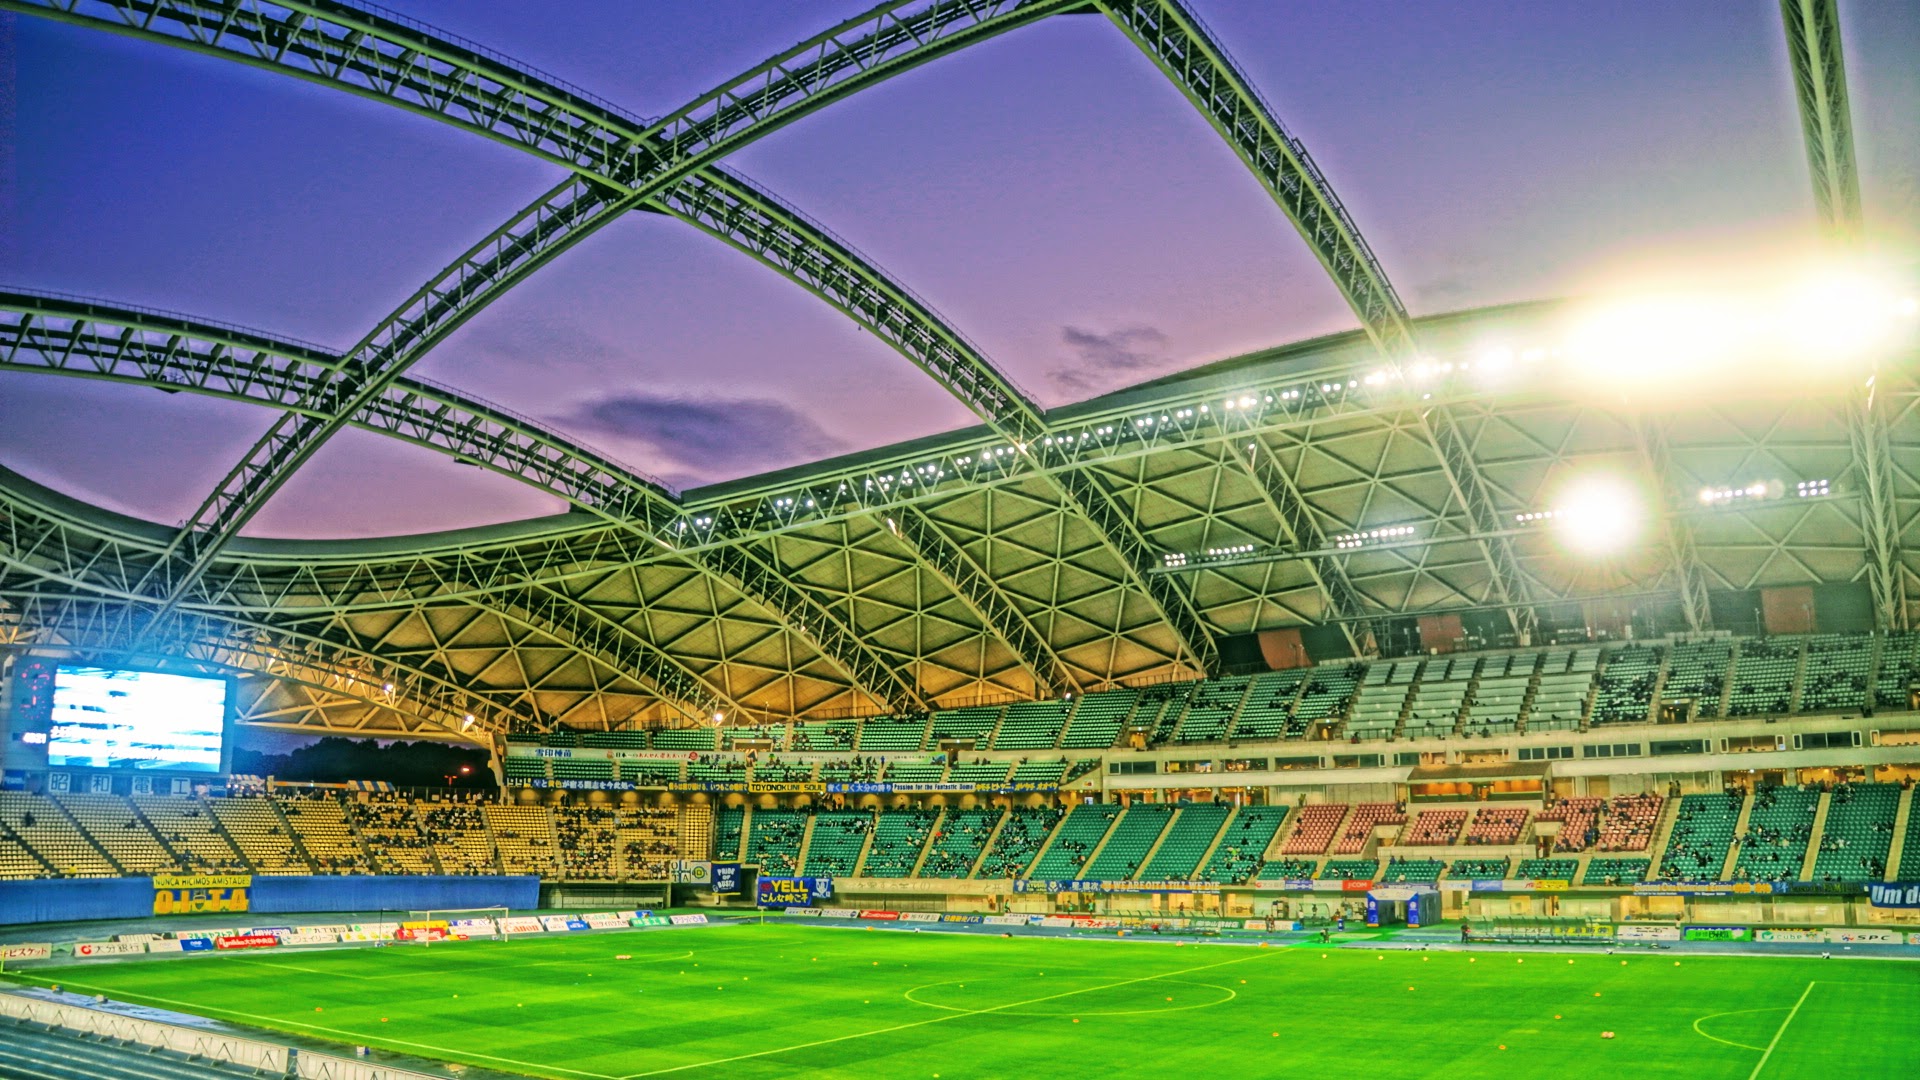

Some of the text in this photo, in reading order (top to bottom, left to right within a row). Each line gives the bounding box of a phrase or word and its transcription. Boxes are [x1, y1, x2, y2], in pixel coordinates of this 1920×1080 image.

[155, 878, 180, 886] NUNCA
[771, 880, 808, 893] YELL
[1113, 881, 1220, 890] WE ARE OITA TILL WE DIE
[760, 893, 808, 903] こんな時こそ
[1871, 885, 1920, 904] Um d
[95, 943, 140, 954] 大分銀行
